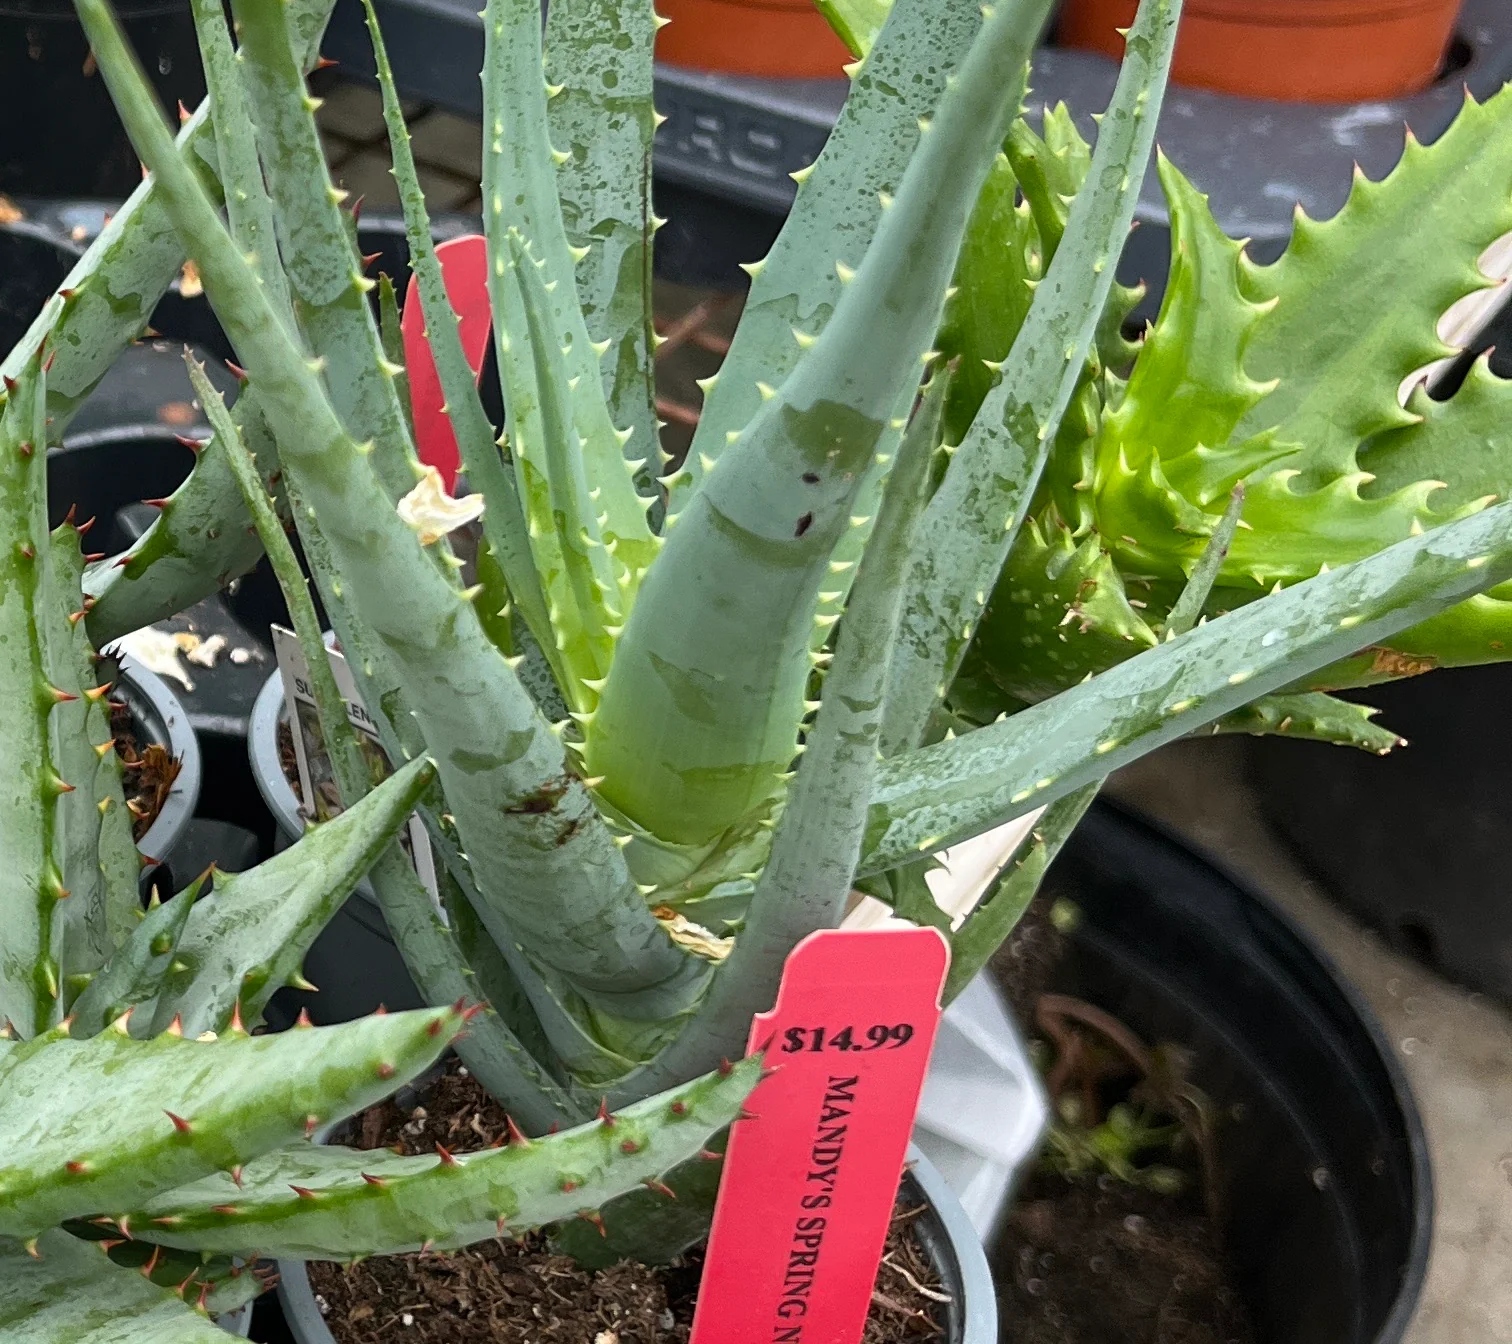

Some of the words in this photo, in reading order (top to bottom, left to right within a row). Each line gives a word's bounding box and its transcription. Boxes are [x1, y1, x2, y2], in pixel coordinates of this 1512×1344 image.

[782, 1023, 915, 1055] $14.99
[800, 1075, 859, 1211] MANDY'S
[777, 1216, 827, 1320] SPRING
